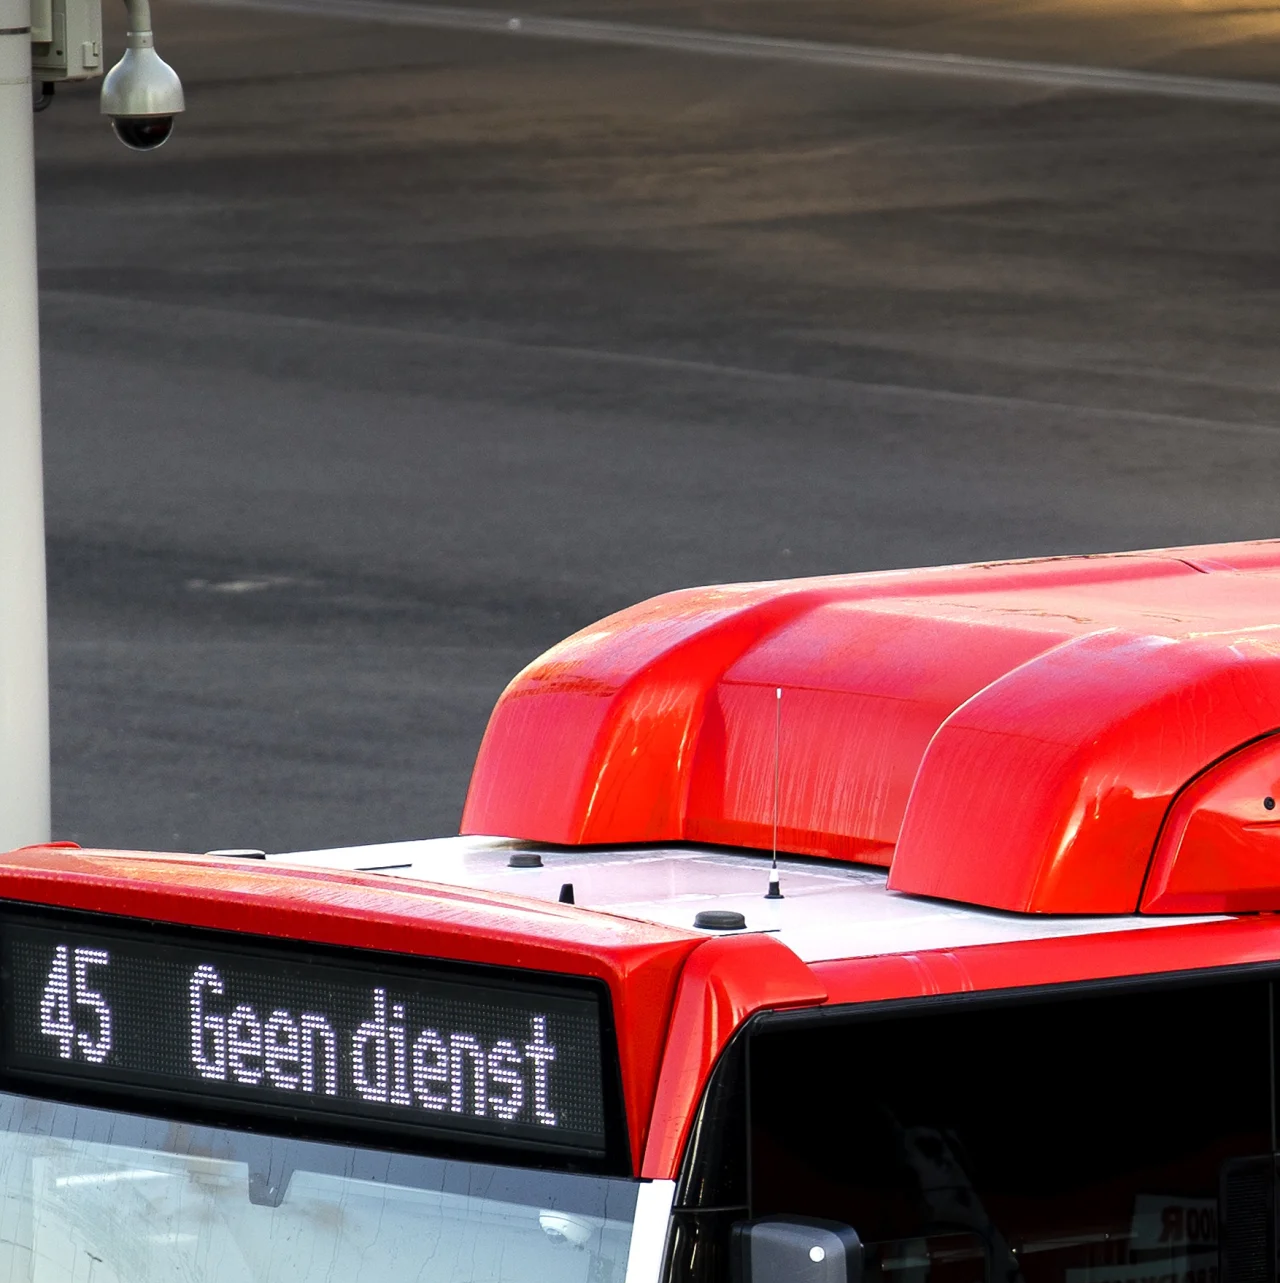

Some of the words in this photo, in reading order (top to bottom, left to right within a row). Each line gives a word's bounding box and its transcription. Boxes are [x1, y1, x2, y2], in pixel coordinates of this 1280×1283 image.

[40, 945, 112, 1064] 45
[189, 964, 336, 1097] Geen
[352, 986, 558, 1127] dienst
